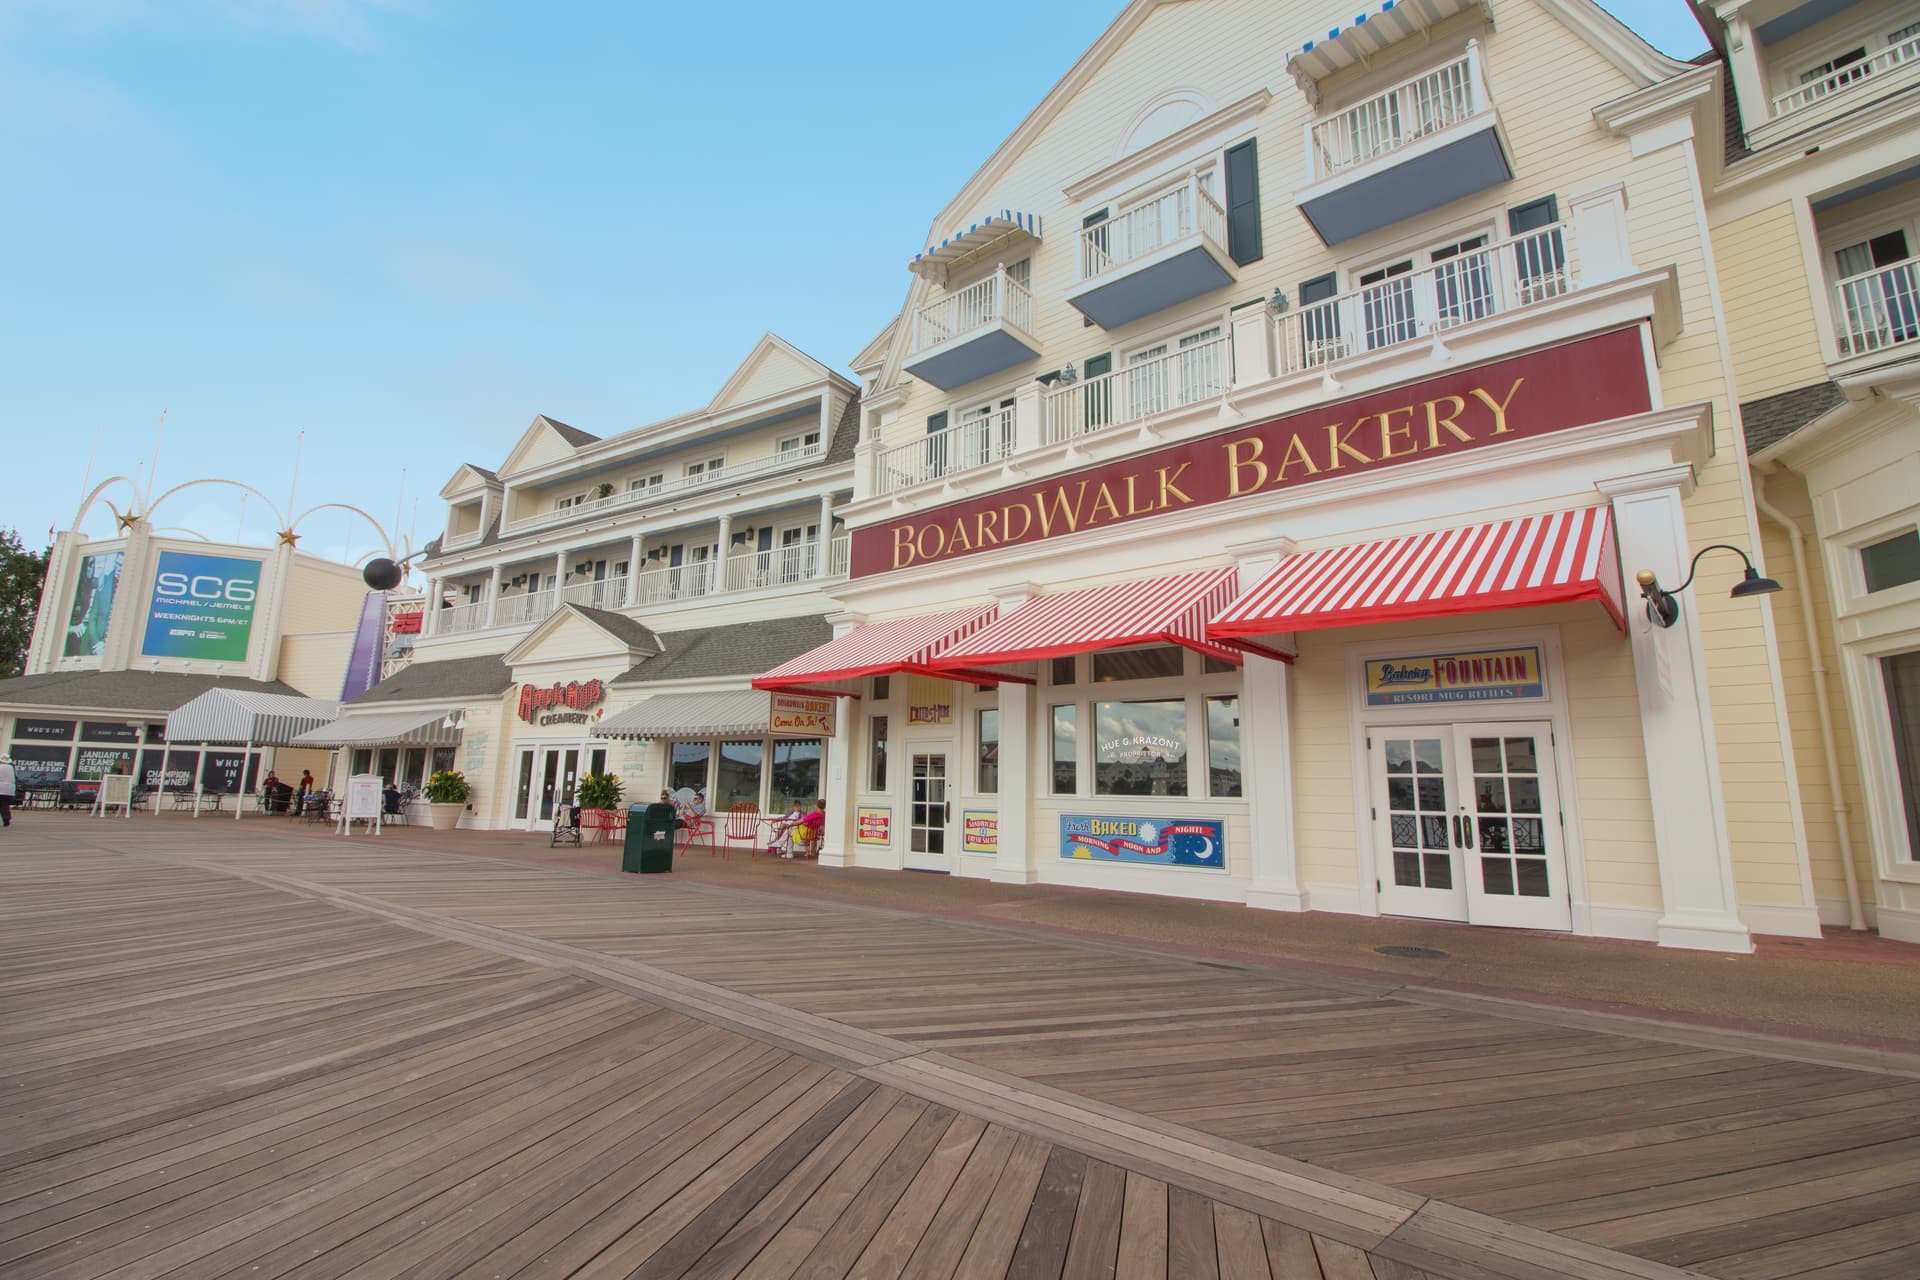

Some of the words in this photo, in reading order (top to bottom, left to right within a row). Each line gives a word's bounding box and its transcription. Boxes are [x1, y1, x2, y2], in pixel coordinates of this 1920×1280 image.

[892, 461, 1194, 570] BOARDWALK
[1223, 377, 1525, 498] BAKERY
[156, 572, 256, 602] SC6
[154, 611, 216, 623] WEEKNIGHTS
[1433, 655, 1528, 689] FOUNTAIN
[1393, 693, 1433, 704] RESORT
[1439, 691, 1464, 701] MUG
[1468, 688, 1513, 699] REFILLS
[805, 700, 830, 713] BAKERY
[540, 713, 588, 727] CREAMERY
[775, 715, 793, 728] Come
[794, 715, 805, 728] On
[1101, 739, 1120, 752] HUE
[1132, 736, 1180, 750] KRAZONT
[80, 759, 86, 767] 2
[87, 759, 114, 767] TEAMS
[81, 751, 120, 760] JANUARY
[225, 769, 237, 777] IN
[1065, 817, 1089, 832] Fresh
[1091, 819, 1137, 837] BAKED
[1077, 835, 1110, 850] MORNING
[1123, 840, 1145, 853] NOON
[1145, 847, 1162, 855] AND
